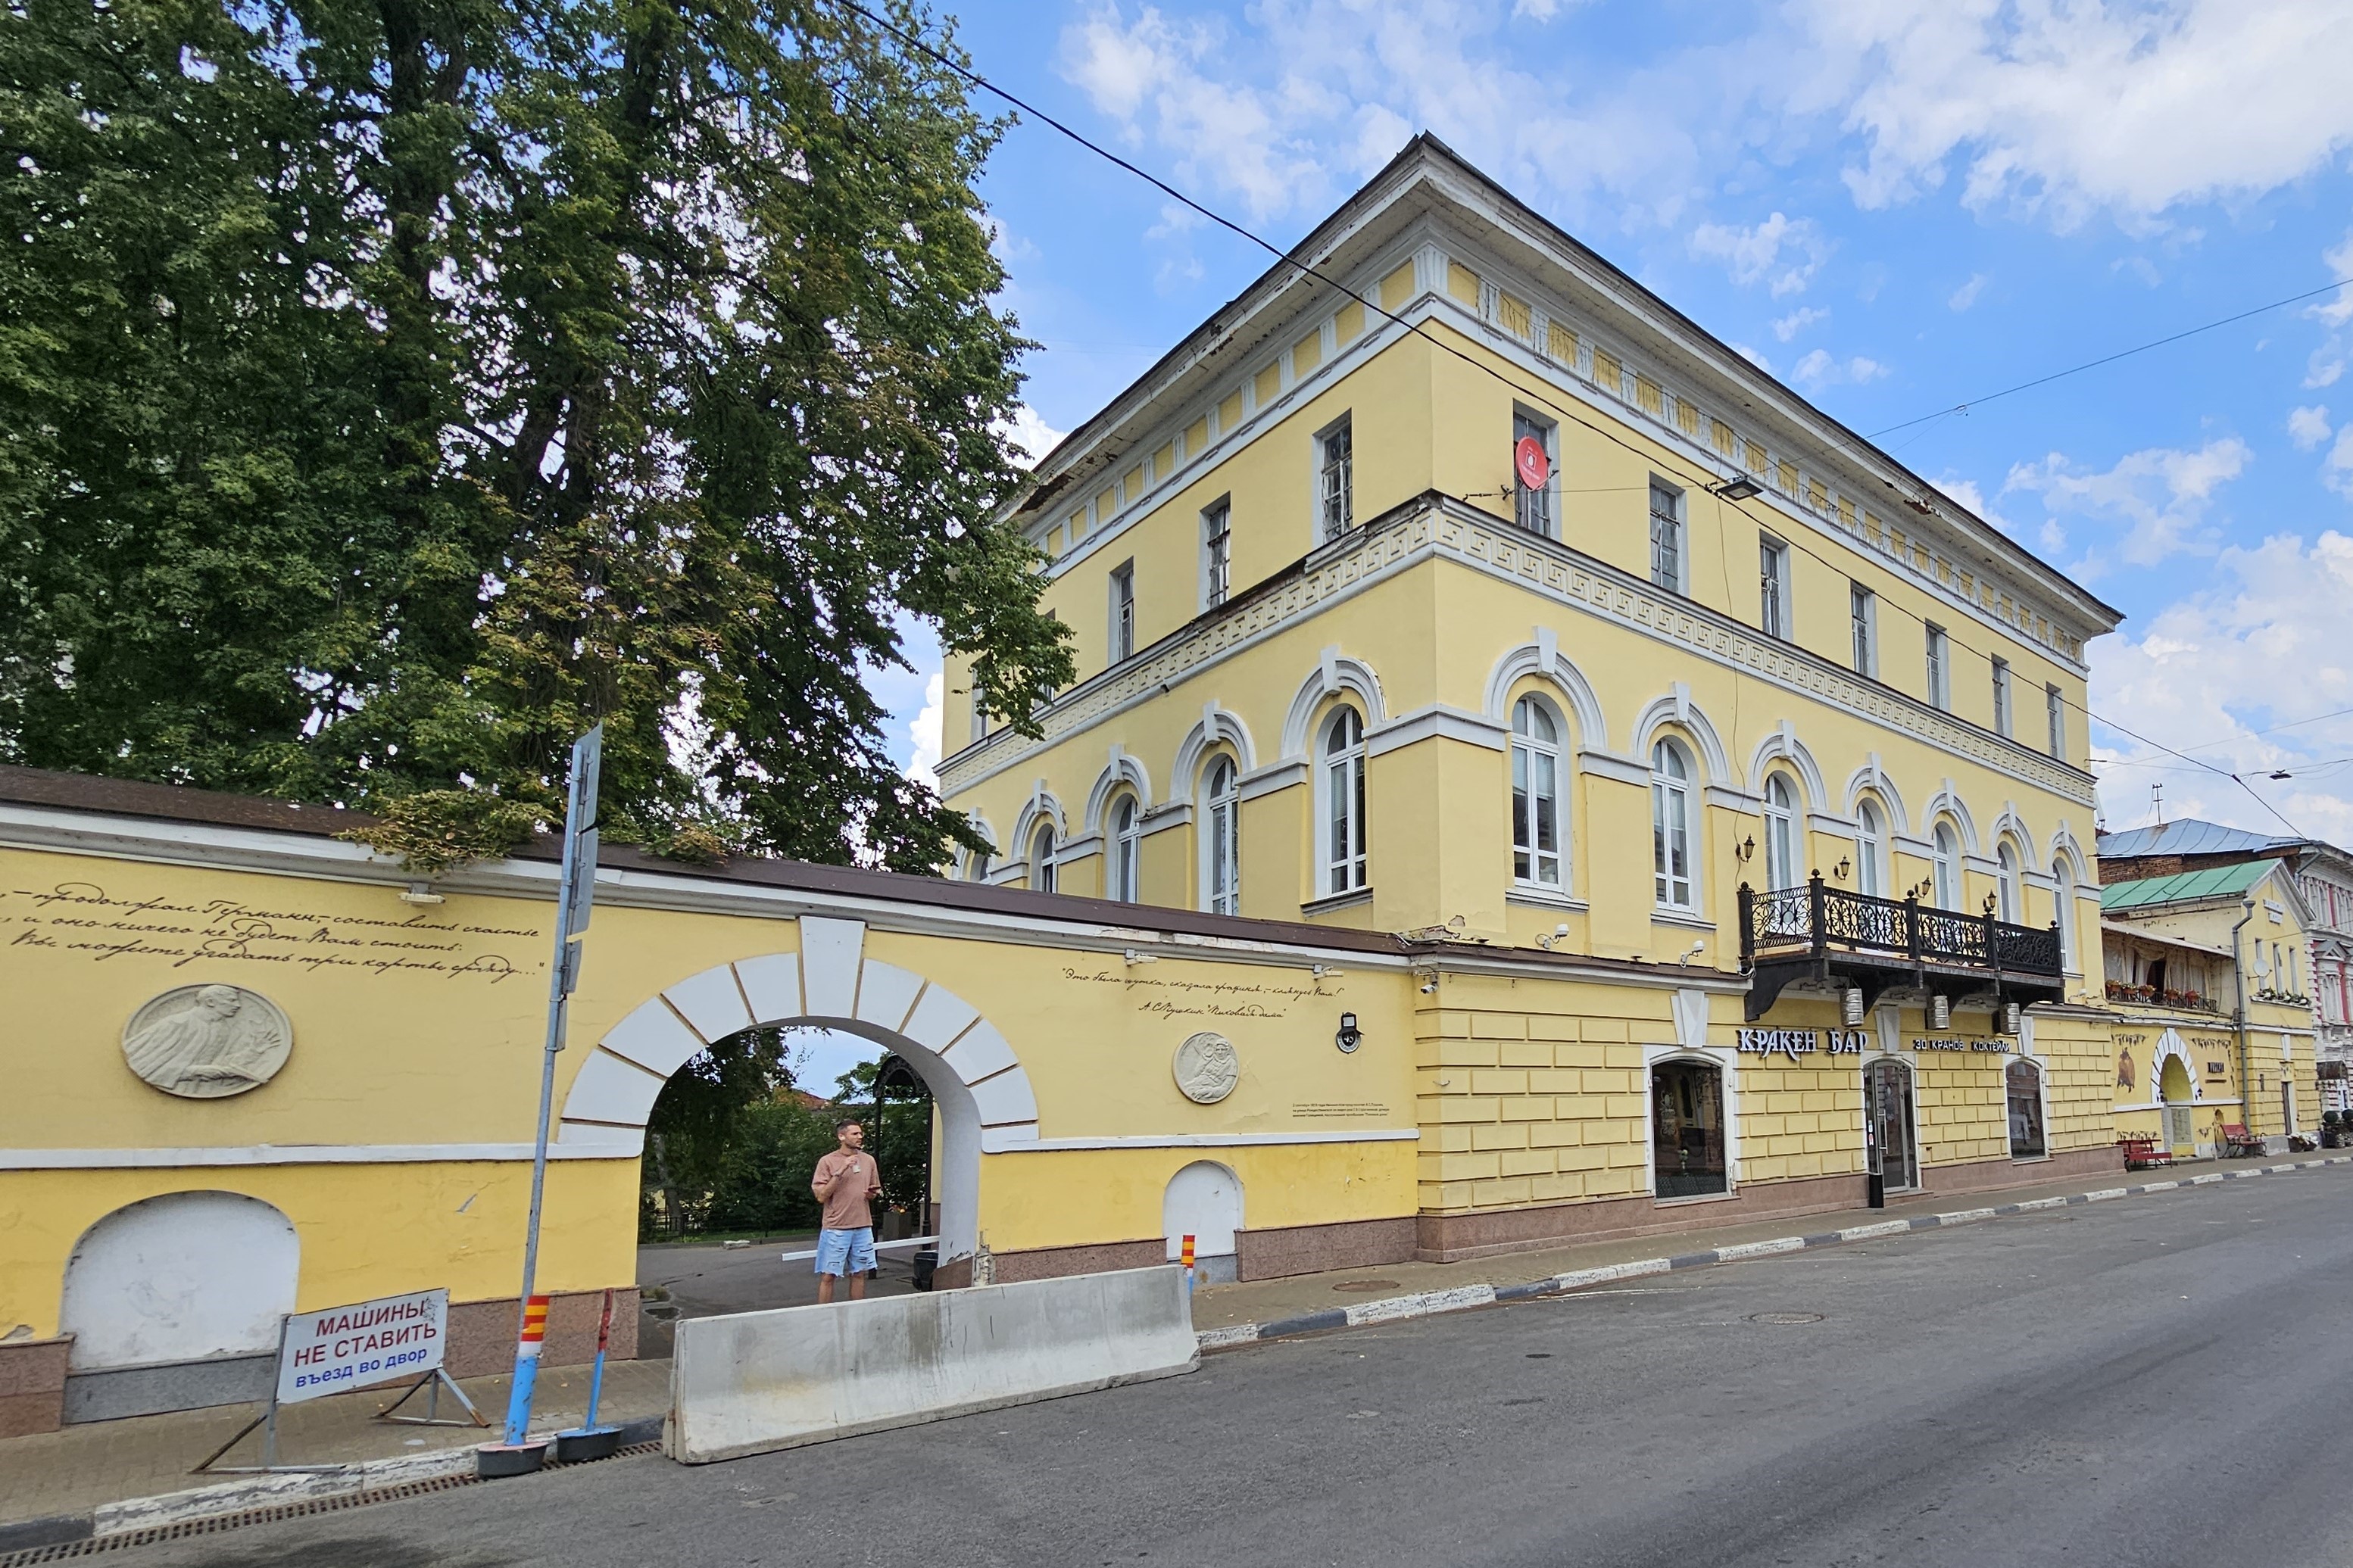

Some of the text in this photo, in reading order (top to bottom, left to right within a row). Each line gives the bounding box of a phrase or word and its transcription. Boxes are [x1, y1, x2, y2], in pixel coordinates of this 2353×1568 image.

[51, 918, 101, 927] оно
[106, 921, 194, 934] ничего
[200, 928, 228, 937] не
[67, 939, 186, 961] можете
[173, 939, 295, 968] угадать
[298, 953, 357, 972] три
[361, 957, 447, 974] карты
[1739, 1029, 1869, 1061] КРАКЕН БАР
[1915, 1040, 2010, 1052] 30 КРАНОВ КОКТЕЙЛИ
[316, 1299, 426, 1337] МАШИНЫ
[294, 1323, 437, 1367] НЕ СТАВИТЬ
[295, 1348, 428, 1388] въезд во двор
